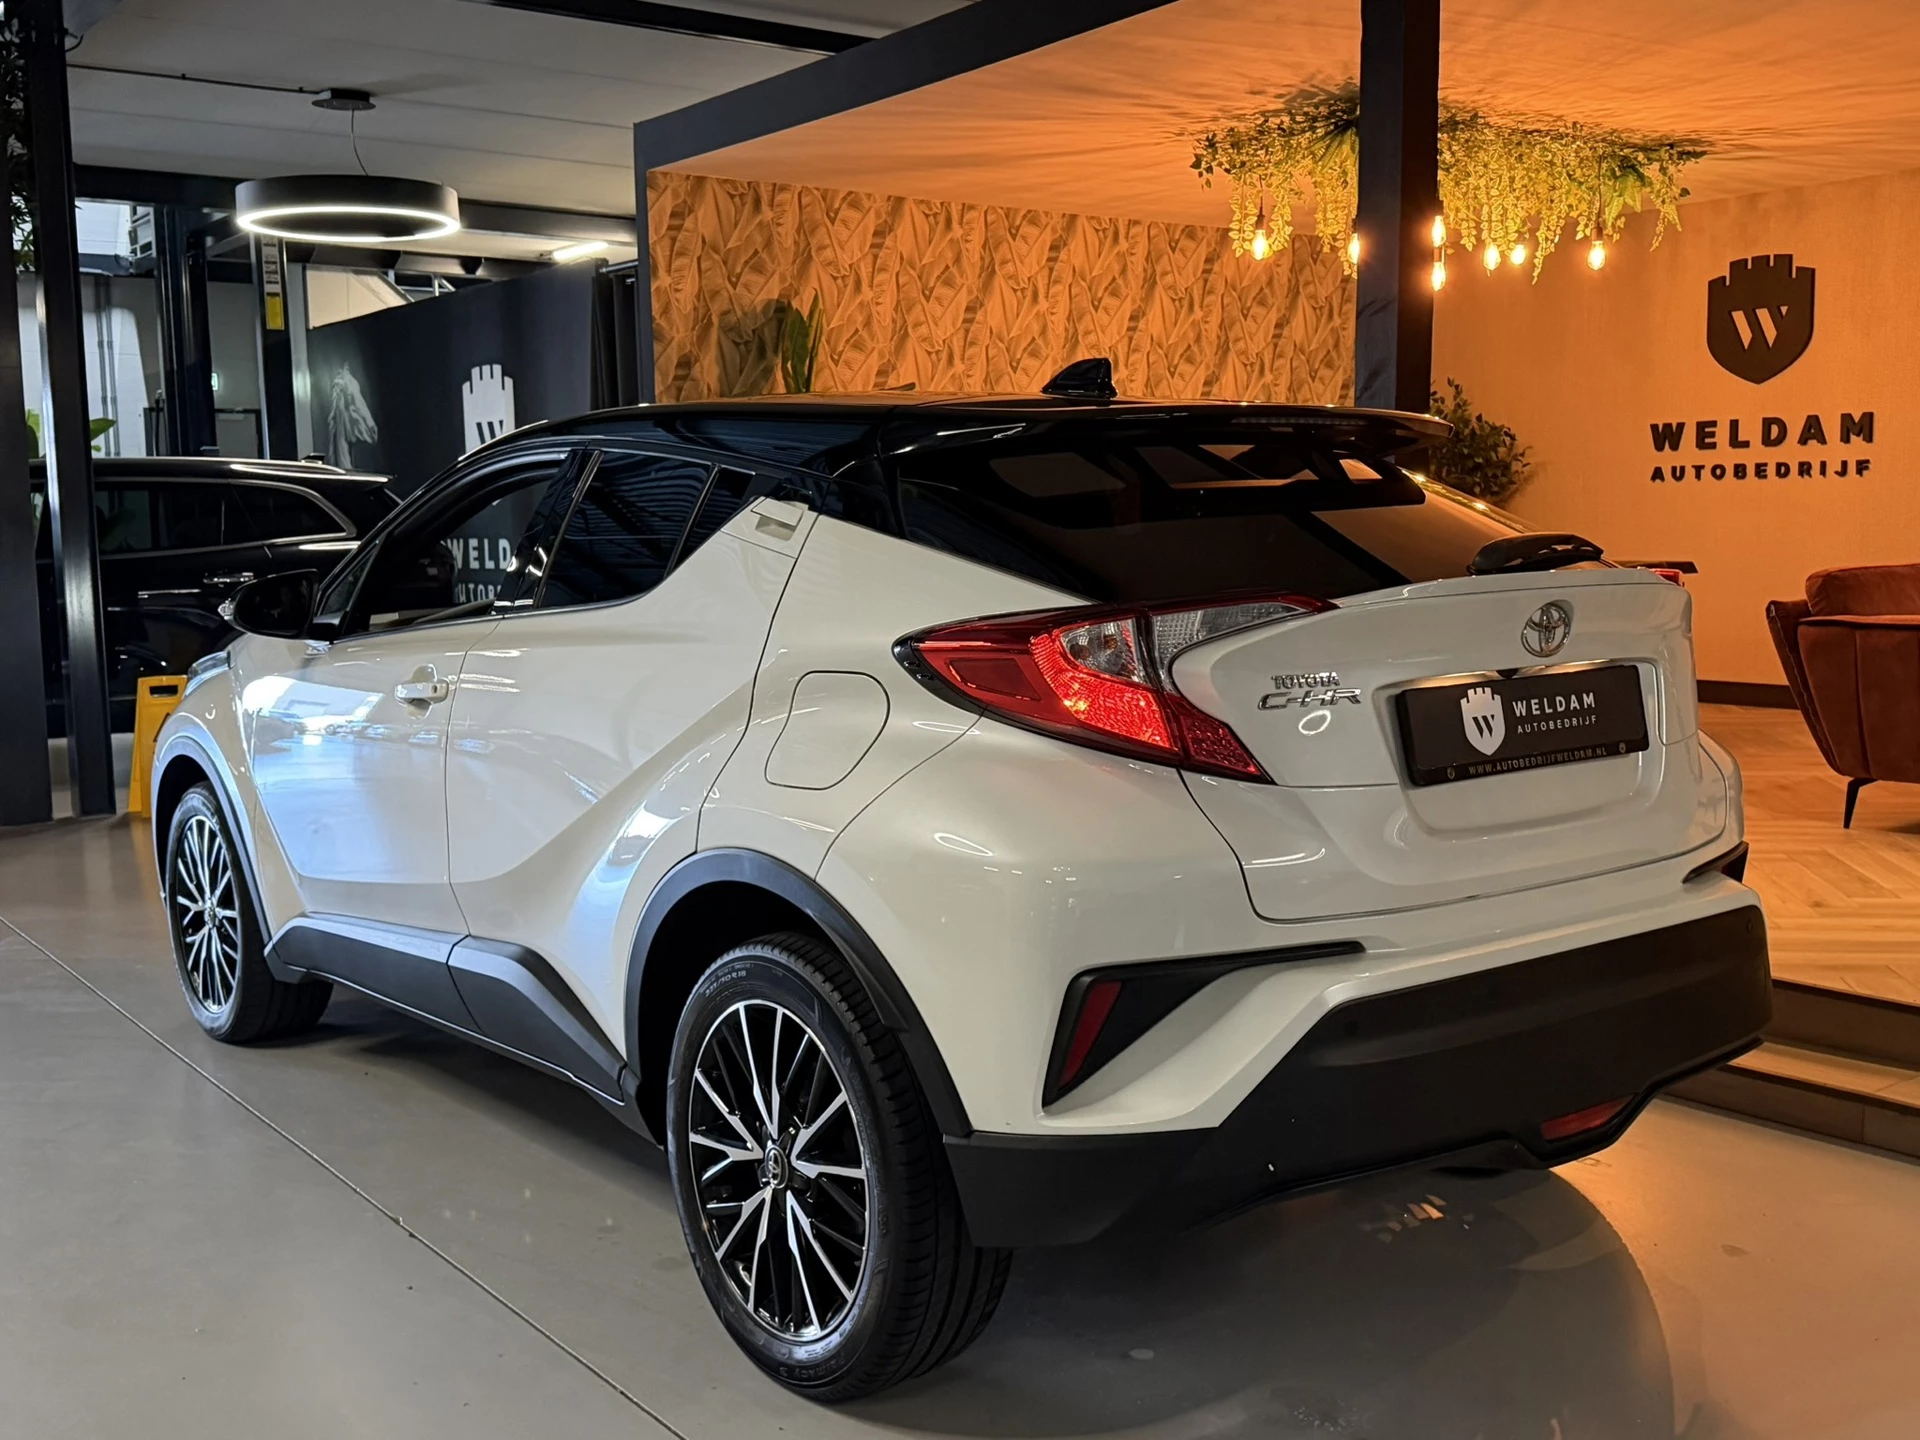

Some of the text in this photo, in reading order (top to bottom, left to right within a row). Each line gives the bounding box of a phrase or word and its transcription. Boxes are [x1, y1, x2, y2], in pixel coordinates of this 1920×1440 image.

[1650, 411, 1875, 452] WELDAM
[1650, 459, 1871, 483] AUTOBEDRIJF
[1271, 672, 1341, 690] TOYOTA
[1258, 688, 1361, 710] C-HR
[1512, 692, 1596, 718] WELDAM
[1517, 715, 1597, 734] AUTOBEDRIJF
[1468, 746, 1608, 775] WWW.AUTOBEDRIJFWELDAM.NL
